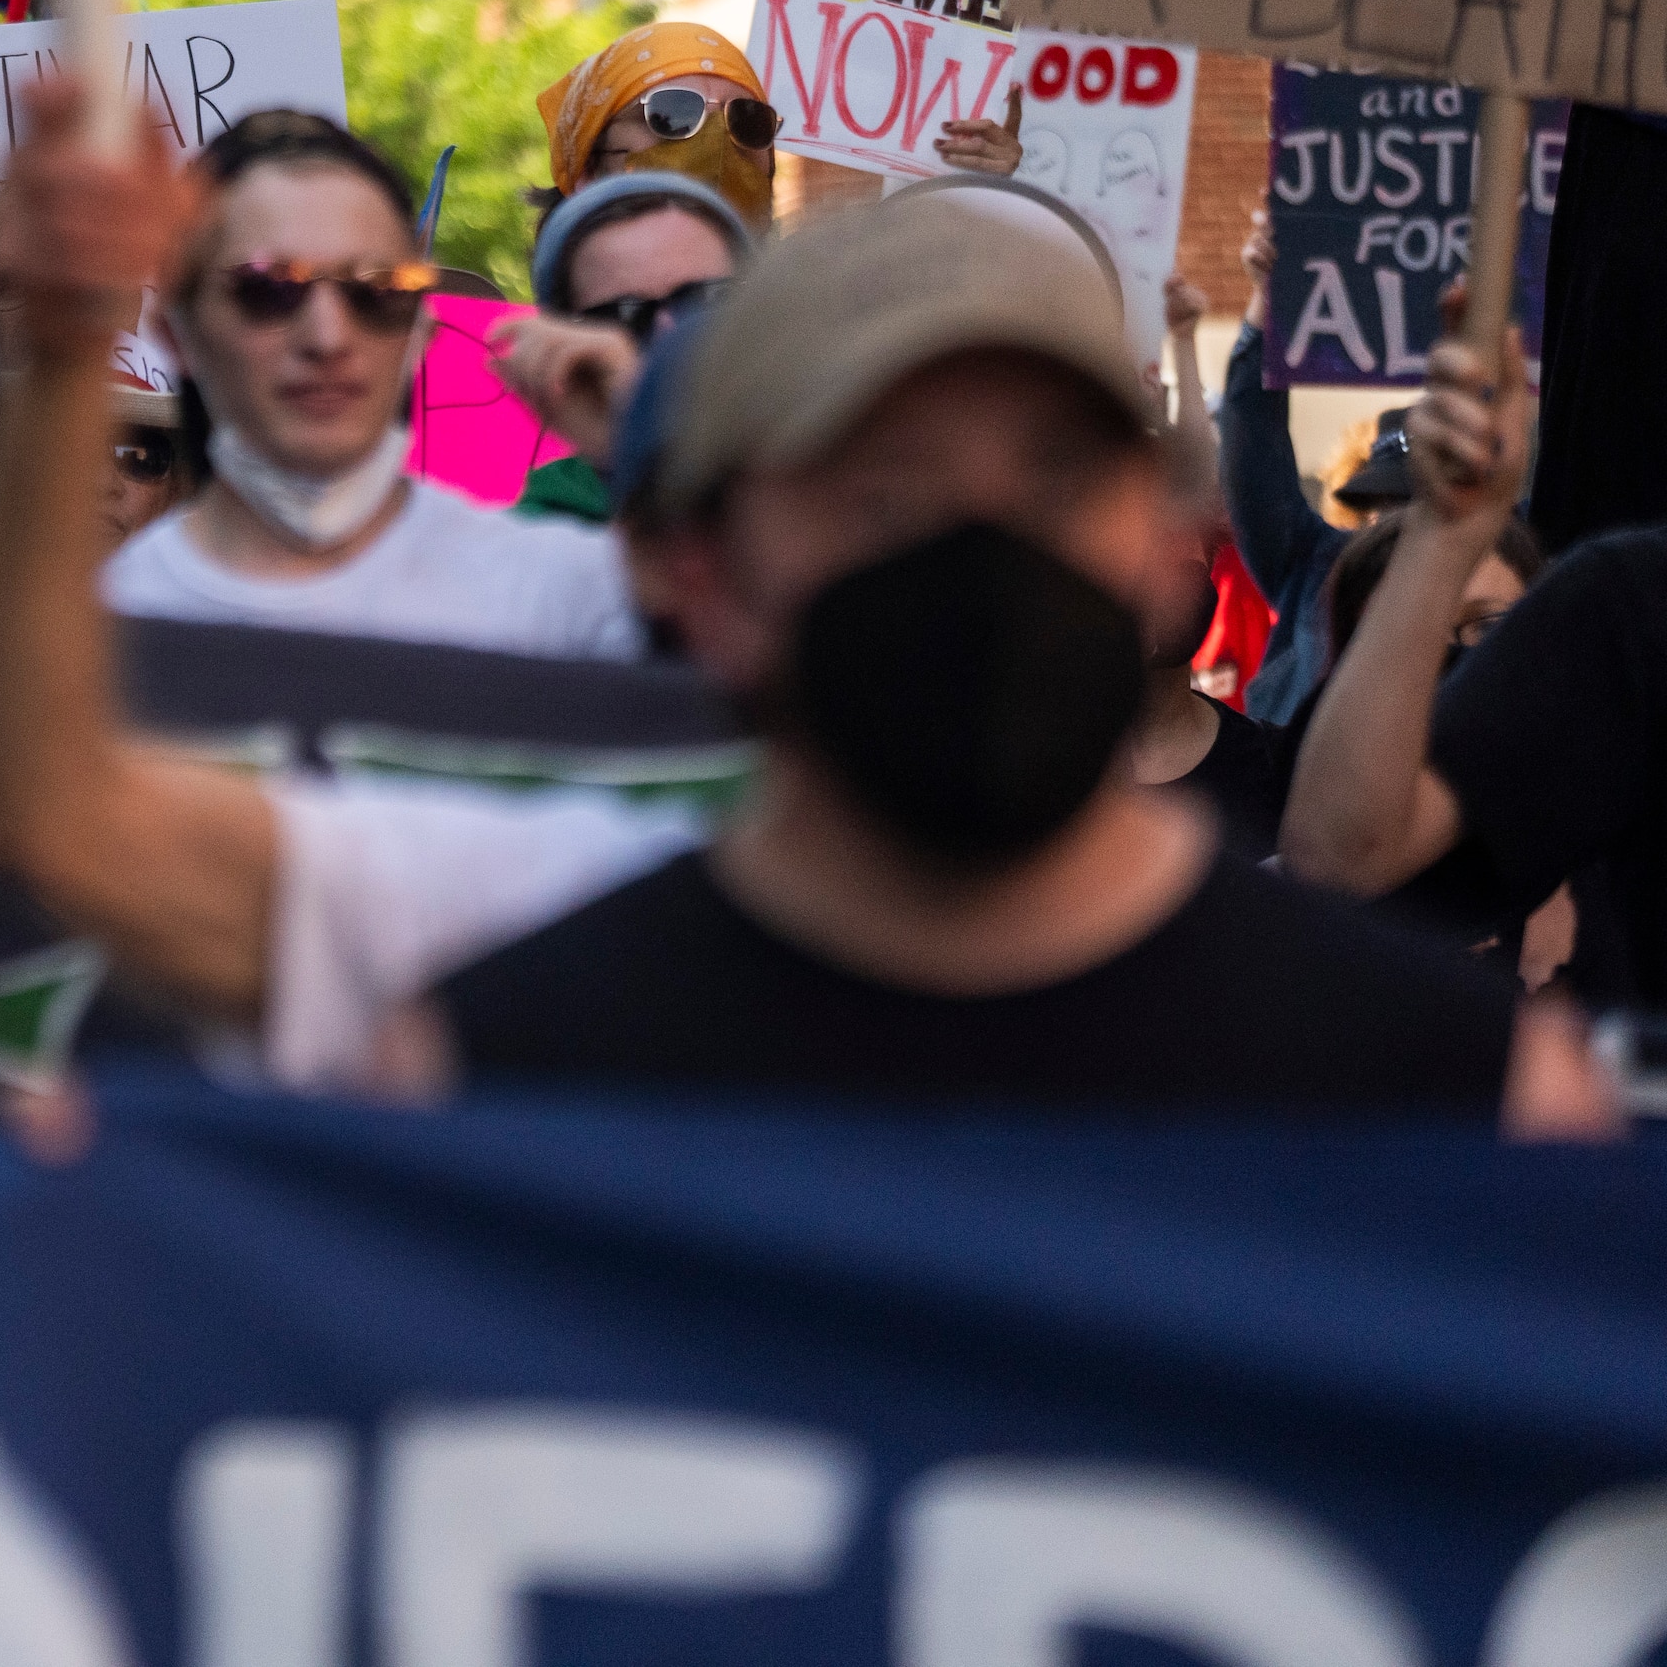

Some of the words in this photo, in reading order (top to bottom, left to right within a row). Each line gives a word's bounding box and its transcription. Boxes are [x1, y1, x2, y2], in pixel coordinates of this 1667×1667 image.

[1021, 42, 1181, 111] OOD
[1359, 80, 1464, 118] and
[1273, 127, 1569, 216] JUSTIE
[1354, 213, 1473, 274] FOR
[1284, 258, 1542, 382] AL
